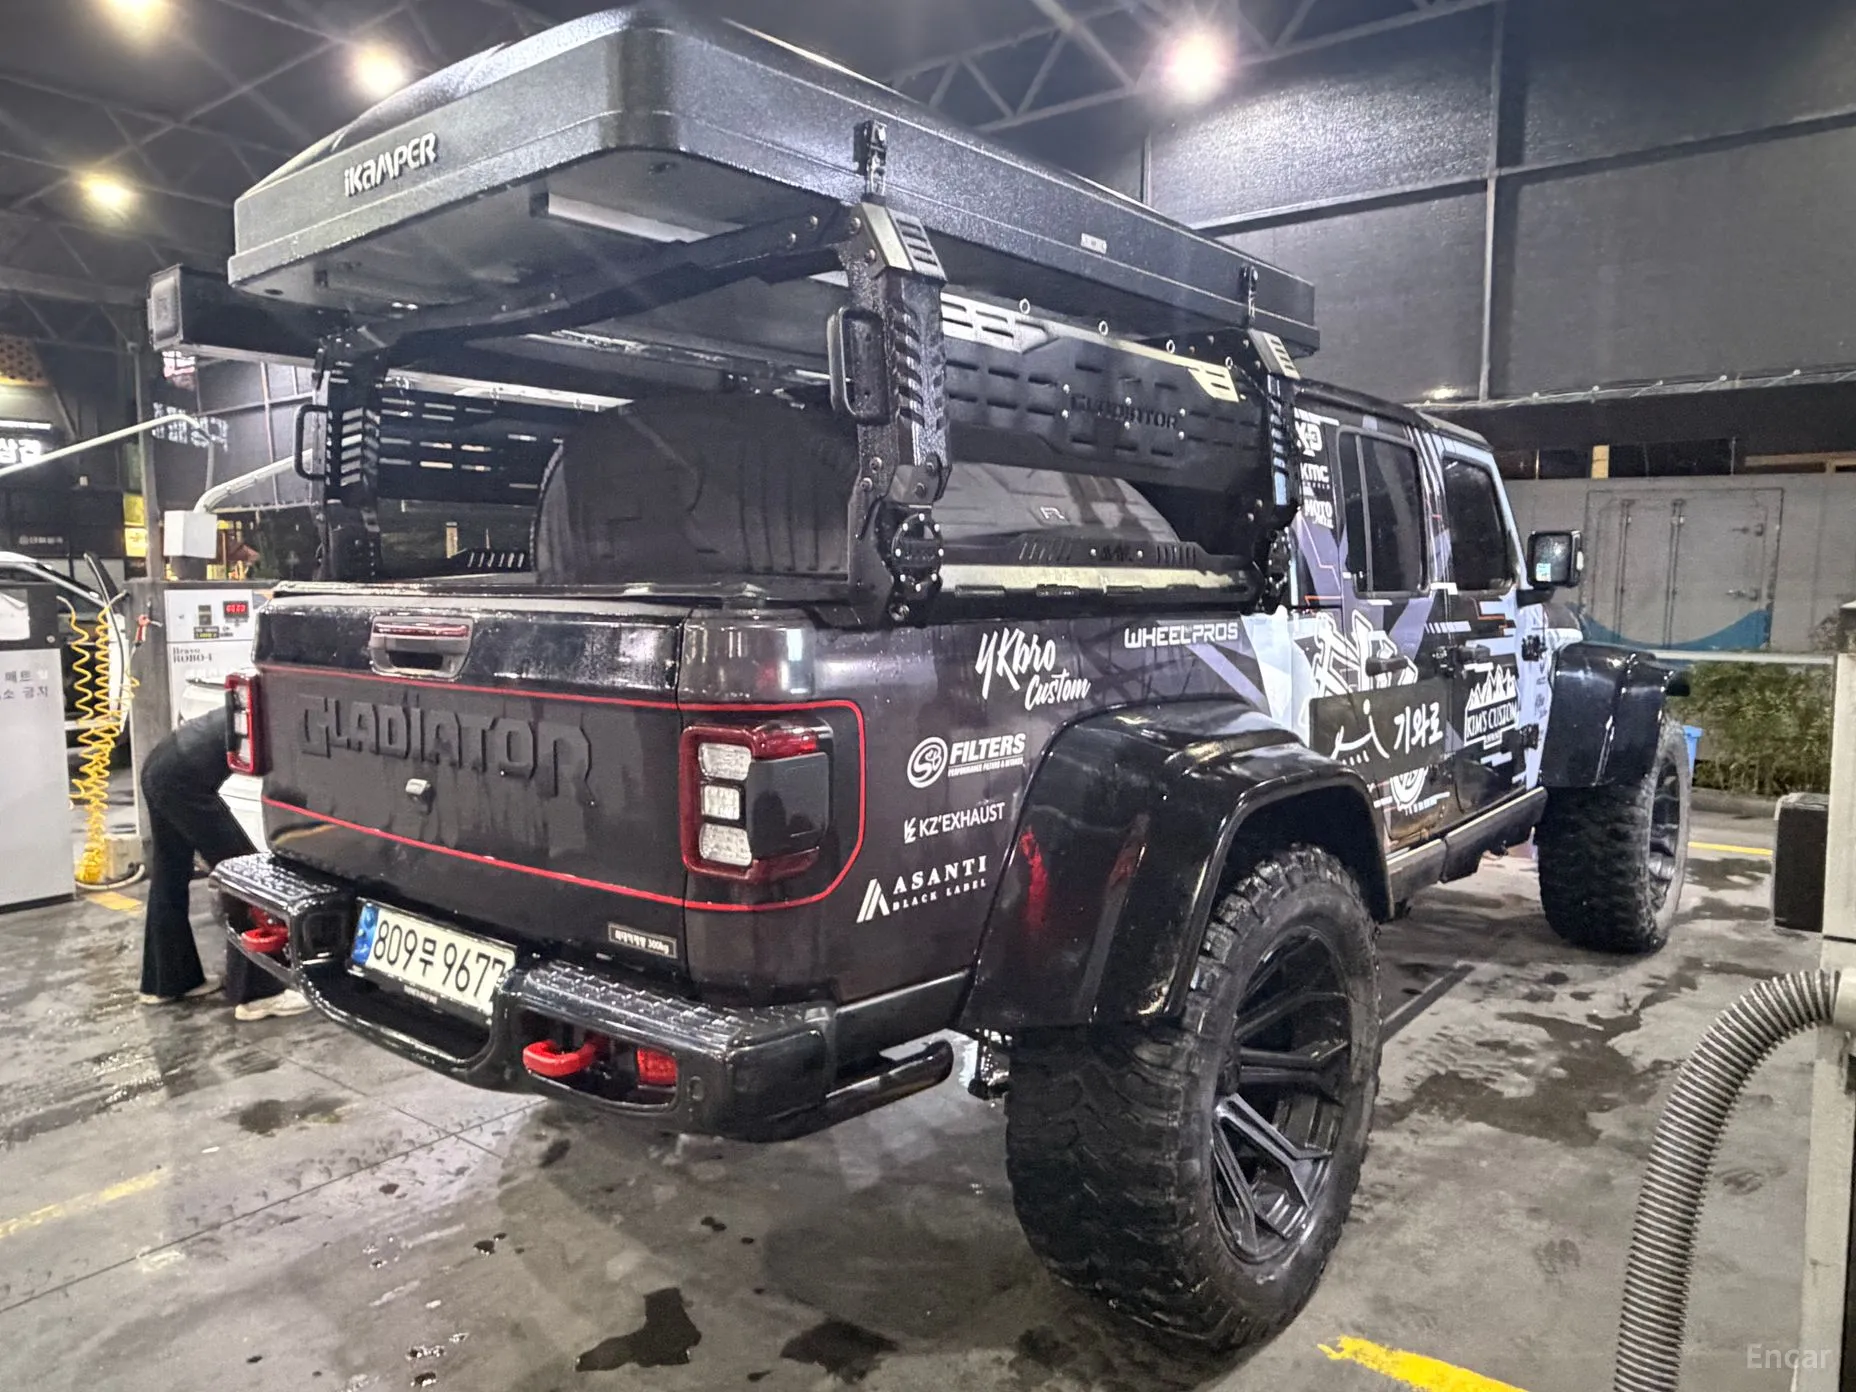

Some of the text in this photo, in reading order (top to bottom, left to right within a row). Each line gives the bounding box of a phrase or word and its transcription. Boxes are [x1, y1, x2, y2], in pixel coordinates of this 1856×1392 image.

[1304, 499, 1333, 517] MOTO
[1025, 668, 1091, 711] Custom
[300, 693, 593, 800] GLADIATOR
[1393, 702, 1443, 754] 기와로
[949, 733, 1026, 765] FILTERS
[892, 878, 986, 911] BLACK LABEL
[893, 855, 987, 895] ASANTI
[373, 920, 506, 997] 809무 9677
